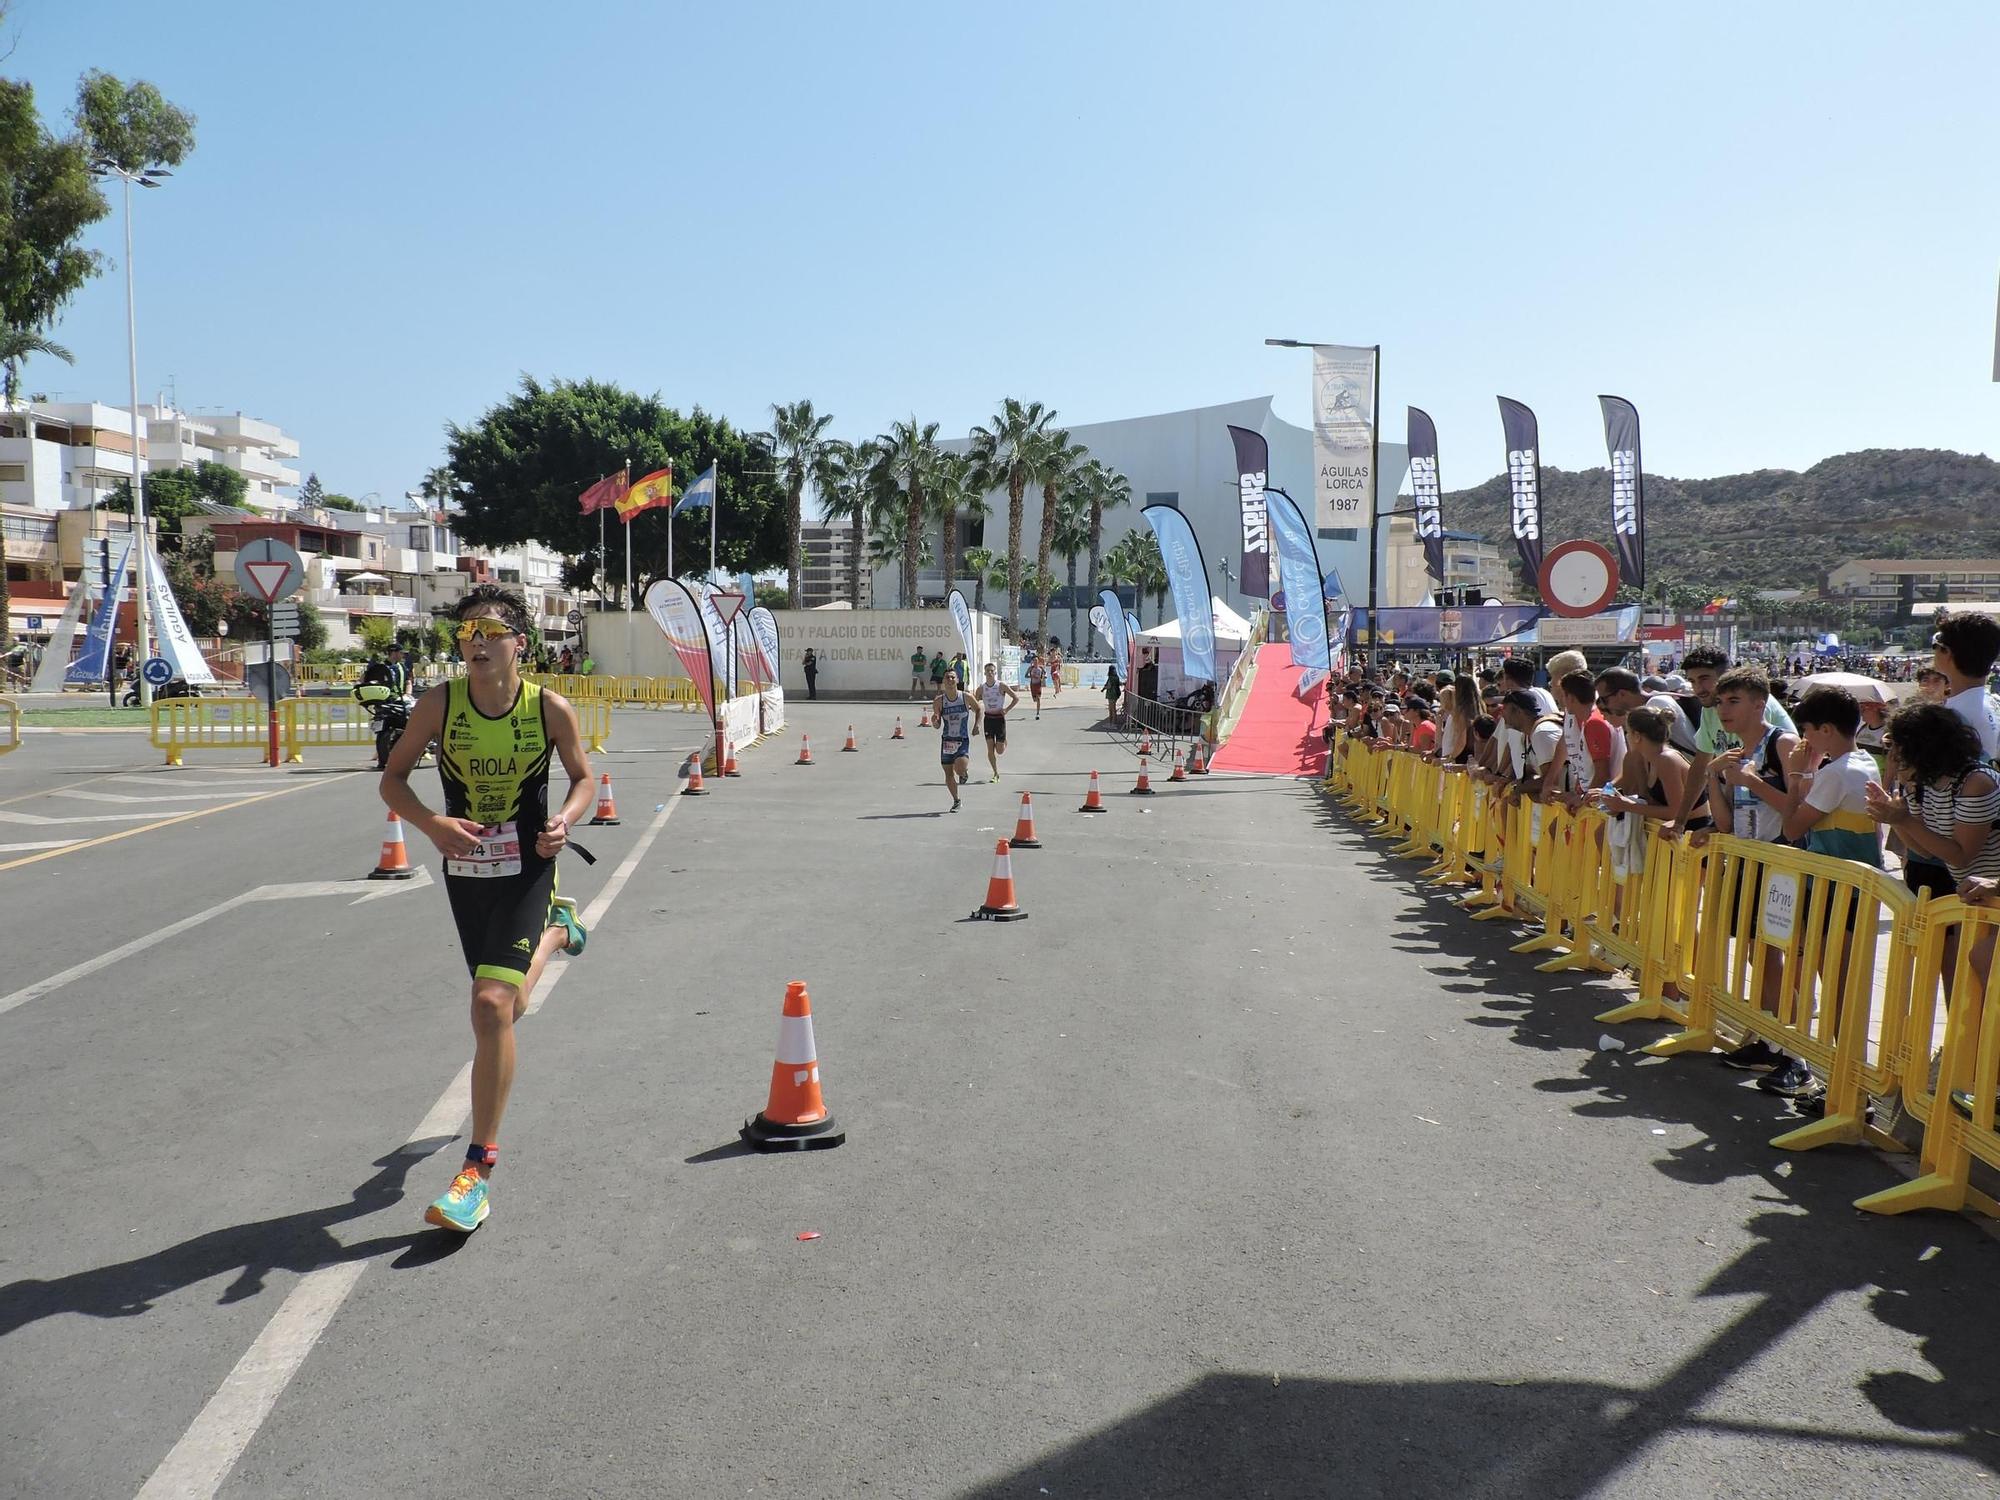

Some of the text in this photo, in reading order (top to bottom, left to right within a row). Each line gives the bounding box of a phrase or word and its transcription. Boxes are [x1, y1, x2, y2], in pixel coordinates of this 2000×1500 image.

[1321, 464, 1369, 478] ÁGUILAS
[1326, 478, 1364, 490] LORCA
[1329, 498, 1360, 511] 1987
[158, 585, 187, 643] ÁGUILAS
[31, 617, 39, 627] P
[798, 626, 806, 639] Y
[809, 626, 858, 639] PALACIO
[861, 626, 876, 638] DE
[880, 625, 951, 638] CONGRESOS
[831, 646, 864, 661] DOÑA
[867, 648, 905, 661] ELENA
[470, 758, 517, 776] RIOLA
